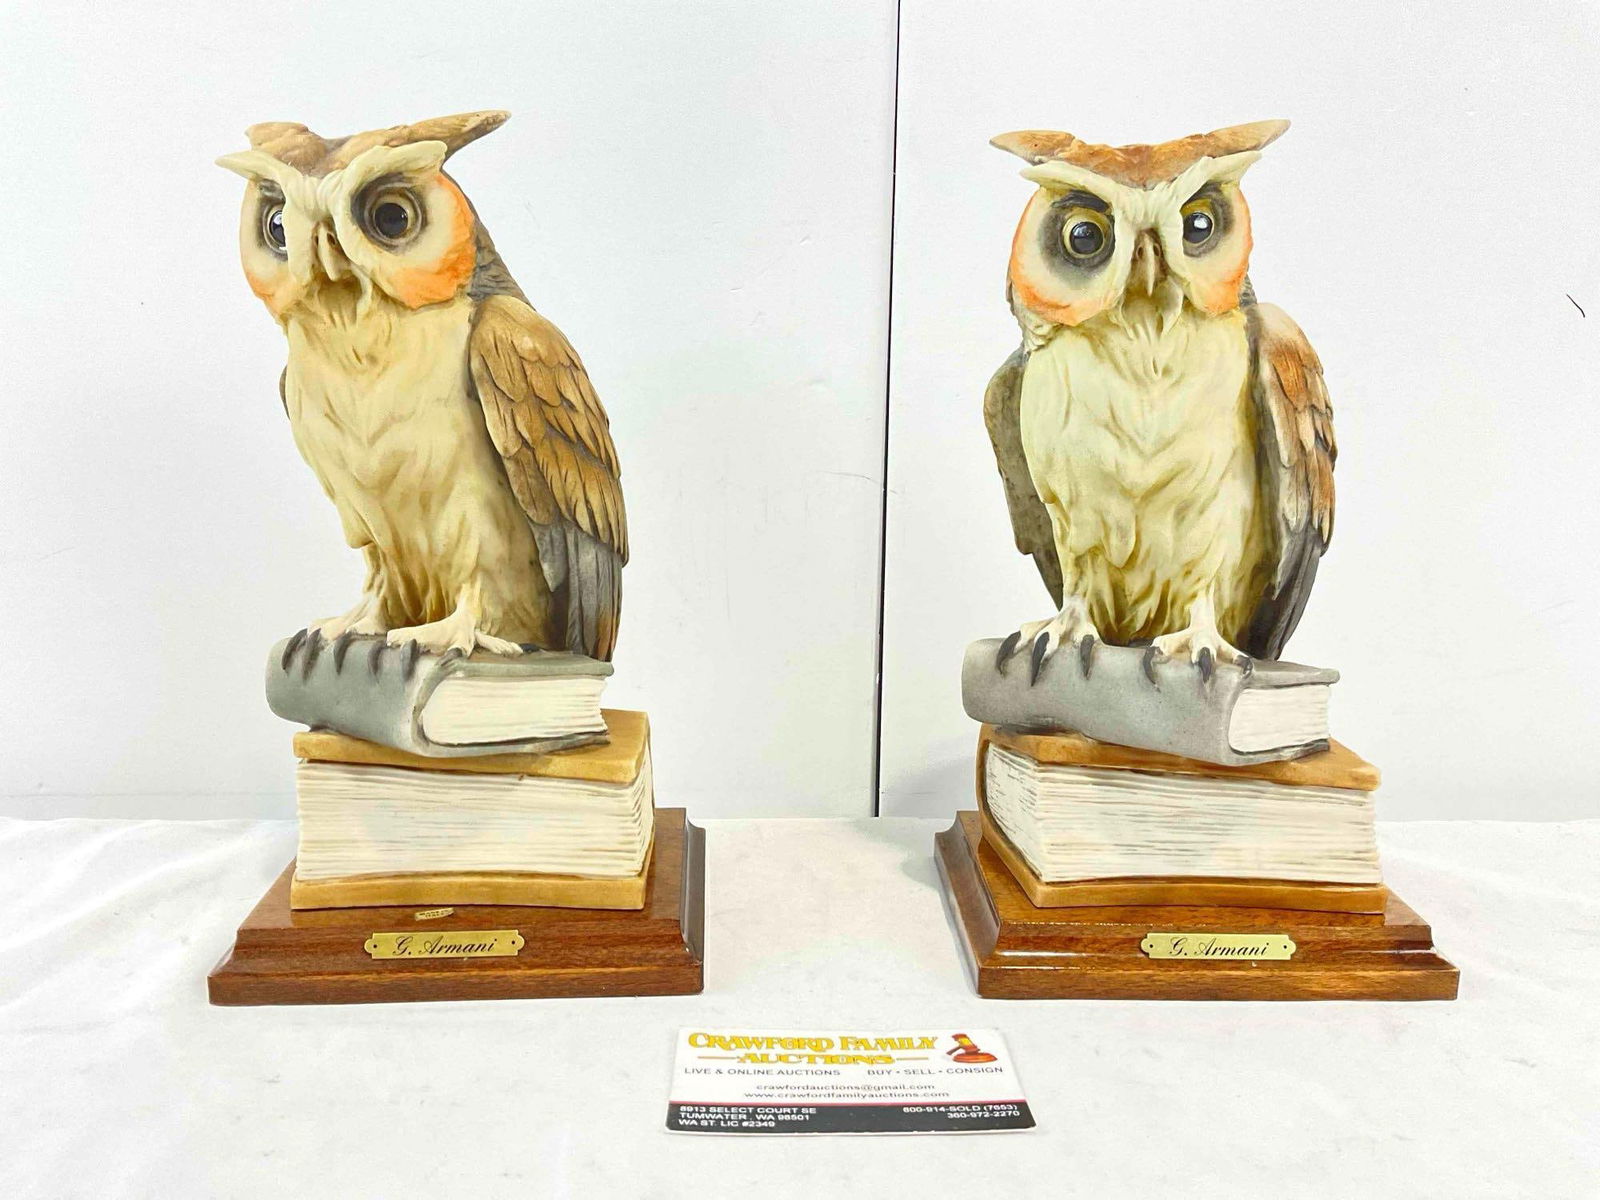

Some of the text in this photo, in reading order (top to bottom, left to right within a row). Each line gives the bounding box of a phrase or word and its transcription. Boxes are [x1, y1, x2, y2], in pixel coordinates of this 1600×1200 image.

[392, 936, 498, 956] G. Armani
[1169, 937, 1269, 956] G. Armani
[688, 1032, 938, 1053] CRAWFORD FAMILY
[737, 1053, 896, 1065] AUCTIONS
[715, 1068, 725, 1076] &
[946, 1067, 1003, 1075] CONSIGN
[756, 1084, 935, 1092] crawfordauctions@gmail.com
